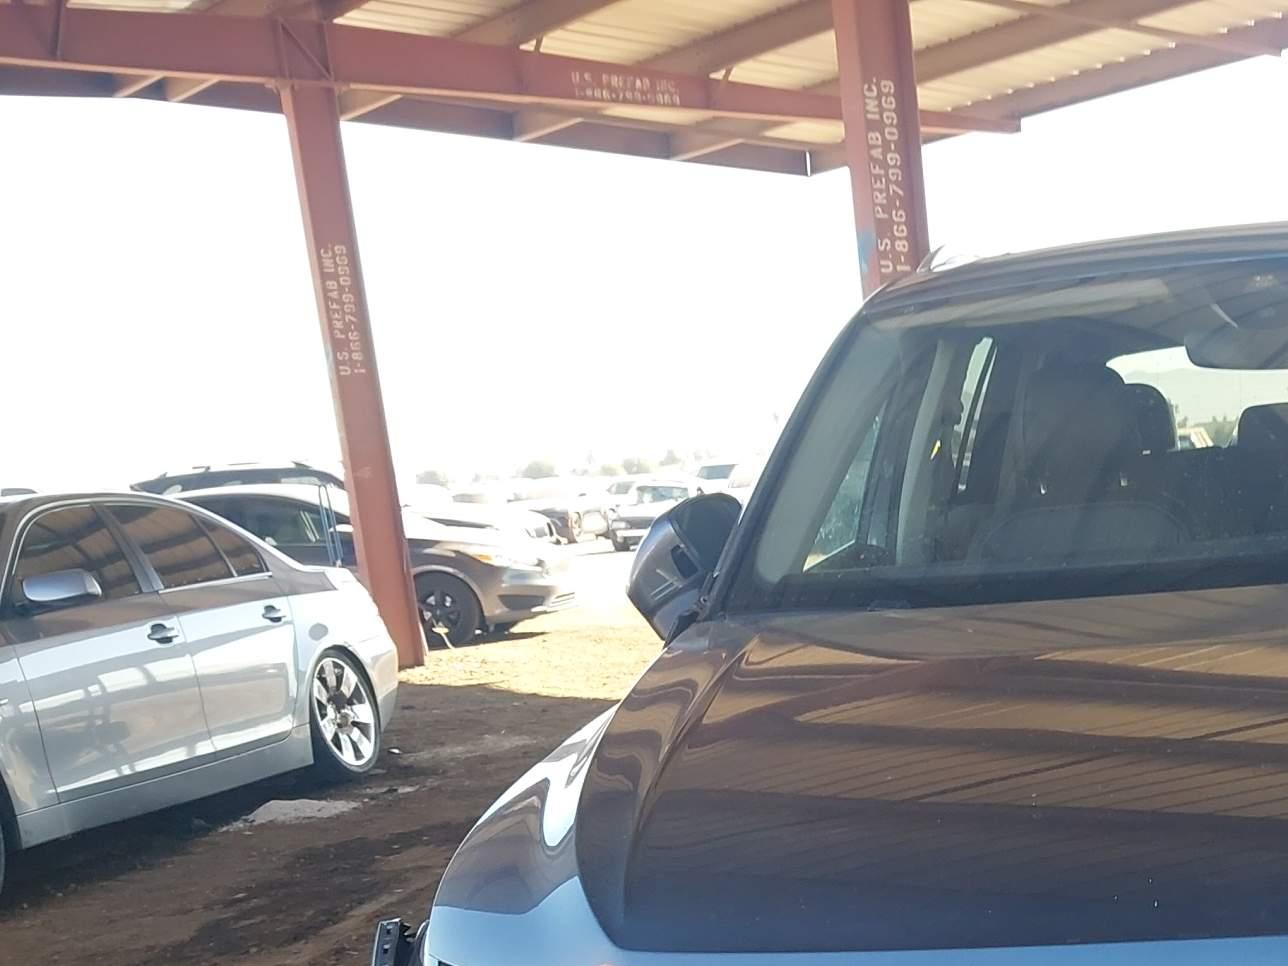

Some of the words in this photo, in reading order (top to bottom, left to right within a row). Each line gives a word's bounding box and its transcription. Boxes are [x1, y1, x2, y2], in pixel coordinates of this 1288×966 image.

[863, 77, 880, 120] INC.
[867, 131, 888, 219] PREFAB
[880, 79, 911, 272] 1-866-799-0969
[320, 243, 335, 273] INC.
[878, 232, 893, 273] U.S.
[325, 280, 346, 339] PREFAB
[336, 347, 352, 376] U.S.
